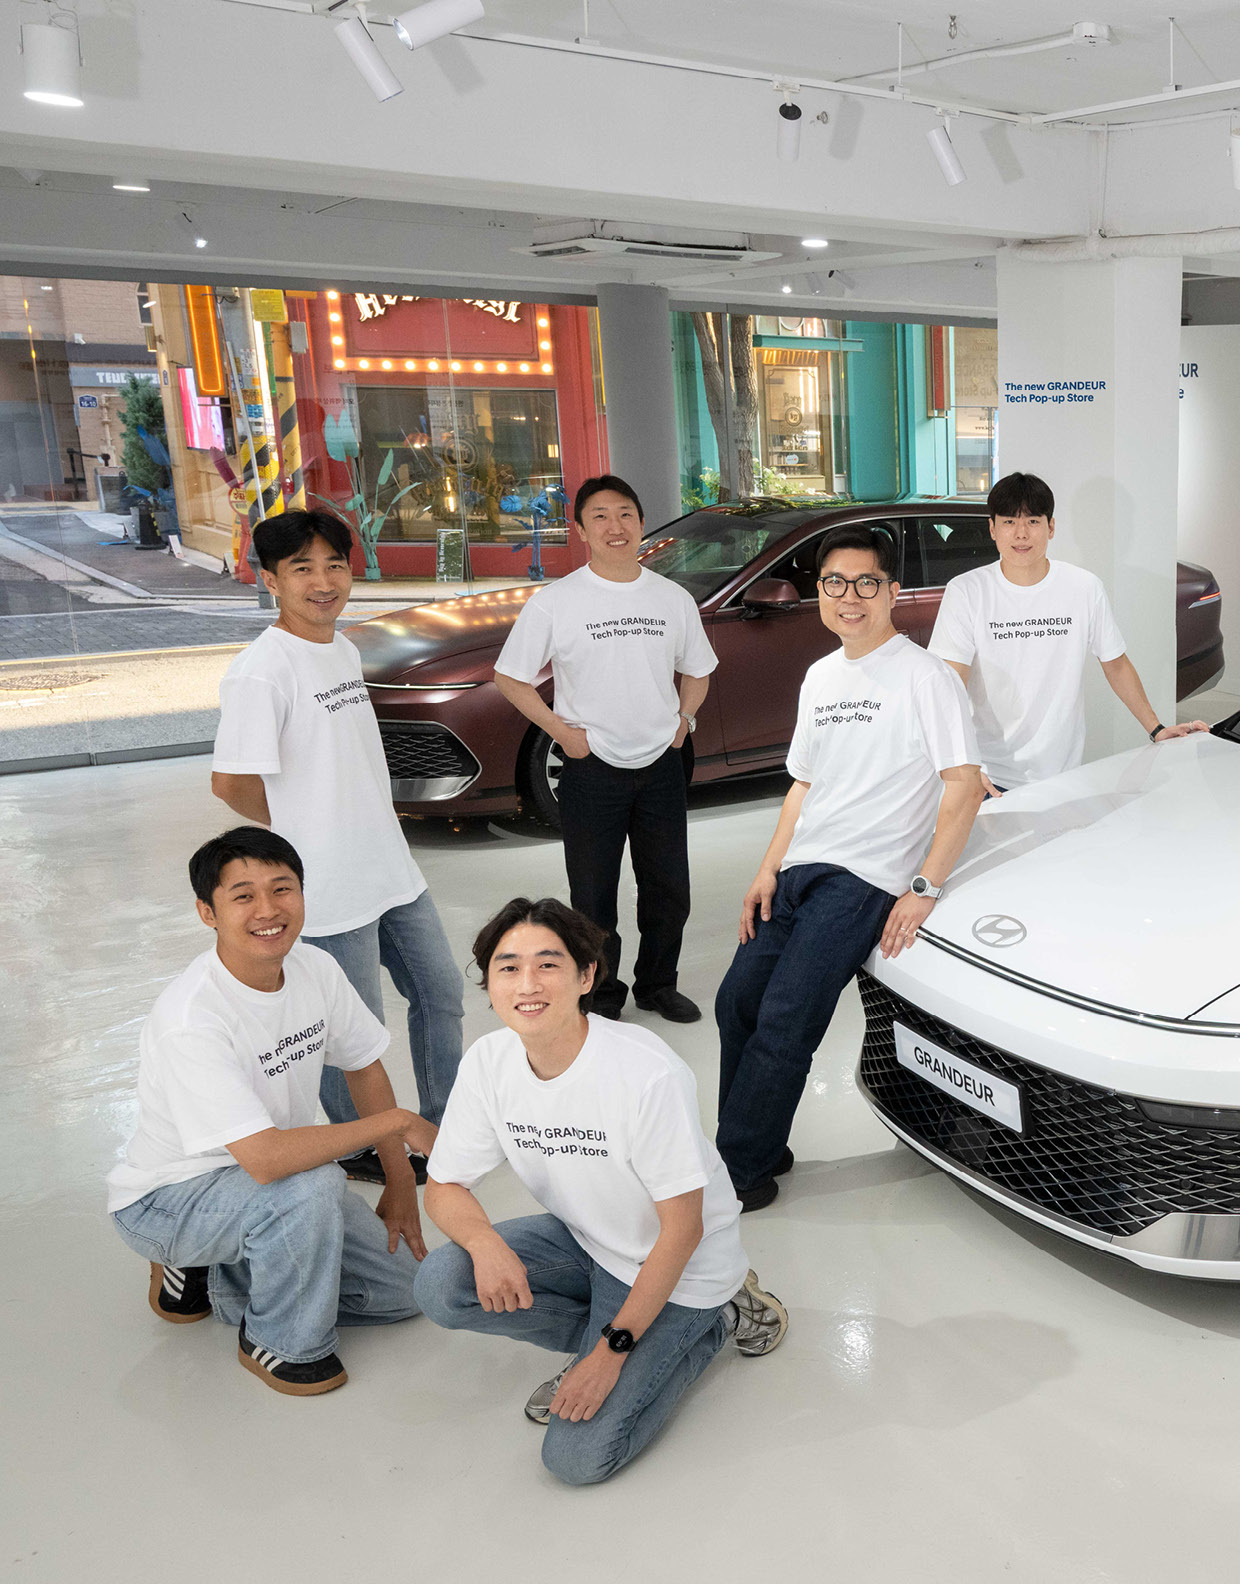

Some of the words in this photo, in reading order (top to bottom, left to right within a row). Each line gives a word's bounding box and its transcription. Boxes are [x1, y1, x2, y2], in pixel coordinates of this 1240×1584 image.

[1047, 381, 1106, 390] GRANDEUR
[1005, 394, 1027, 403] Tech
[1029, 394, 1065, 404] Pop-up
[1067, 393, 1094, 402] Store
[620, 617, 666, 626] GRANDEUR
[1024, 617, 1072, 626] GRANDEUR
[591, 631, 612, 640] Tech
[613, 628, 642, 637] Pop-up
[643, 628, 664, 636] Store
[993, 631, 1013, 640] Tech
[1015, 630, 1045, 638] Pop-up
[1047, 628, 1068, 636] Store
[314, 692, 331, 704] The
[325, 701, 341, 714] Tech
[854, 712, 873, 723] tore
[259, 1052, 273, 1065] he
[278, 1019, 325, 1051] GRANDEUR
[264, 1060, 290, 1079] Tech
[306, 1038, 324, 1055] Stor
[914, 1046, 996, 1107] GRANDEUR
[506, 1122, 526, 1133] The
[514, 1138, 541, 1149] Tech
[540, 1144, 578, 1157] op-up
